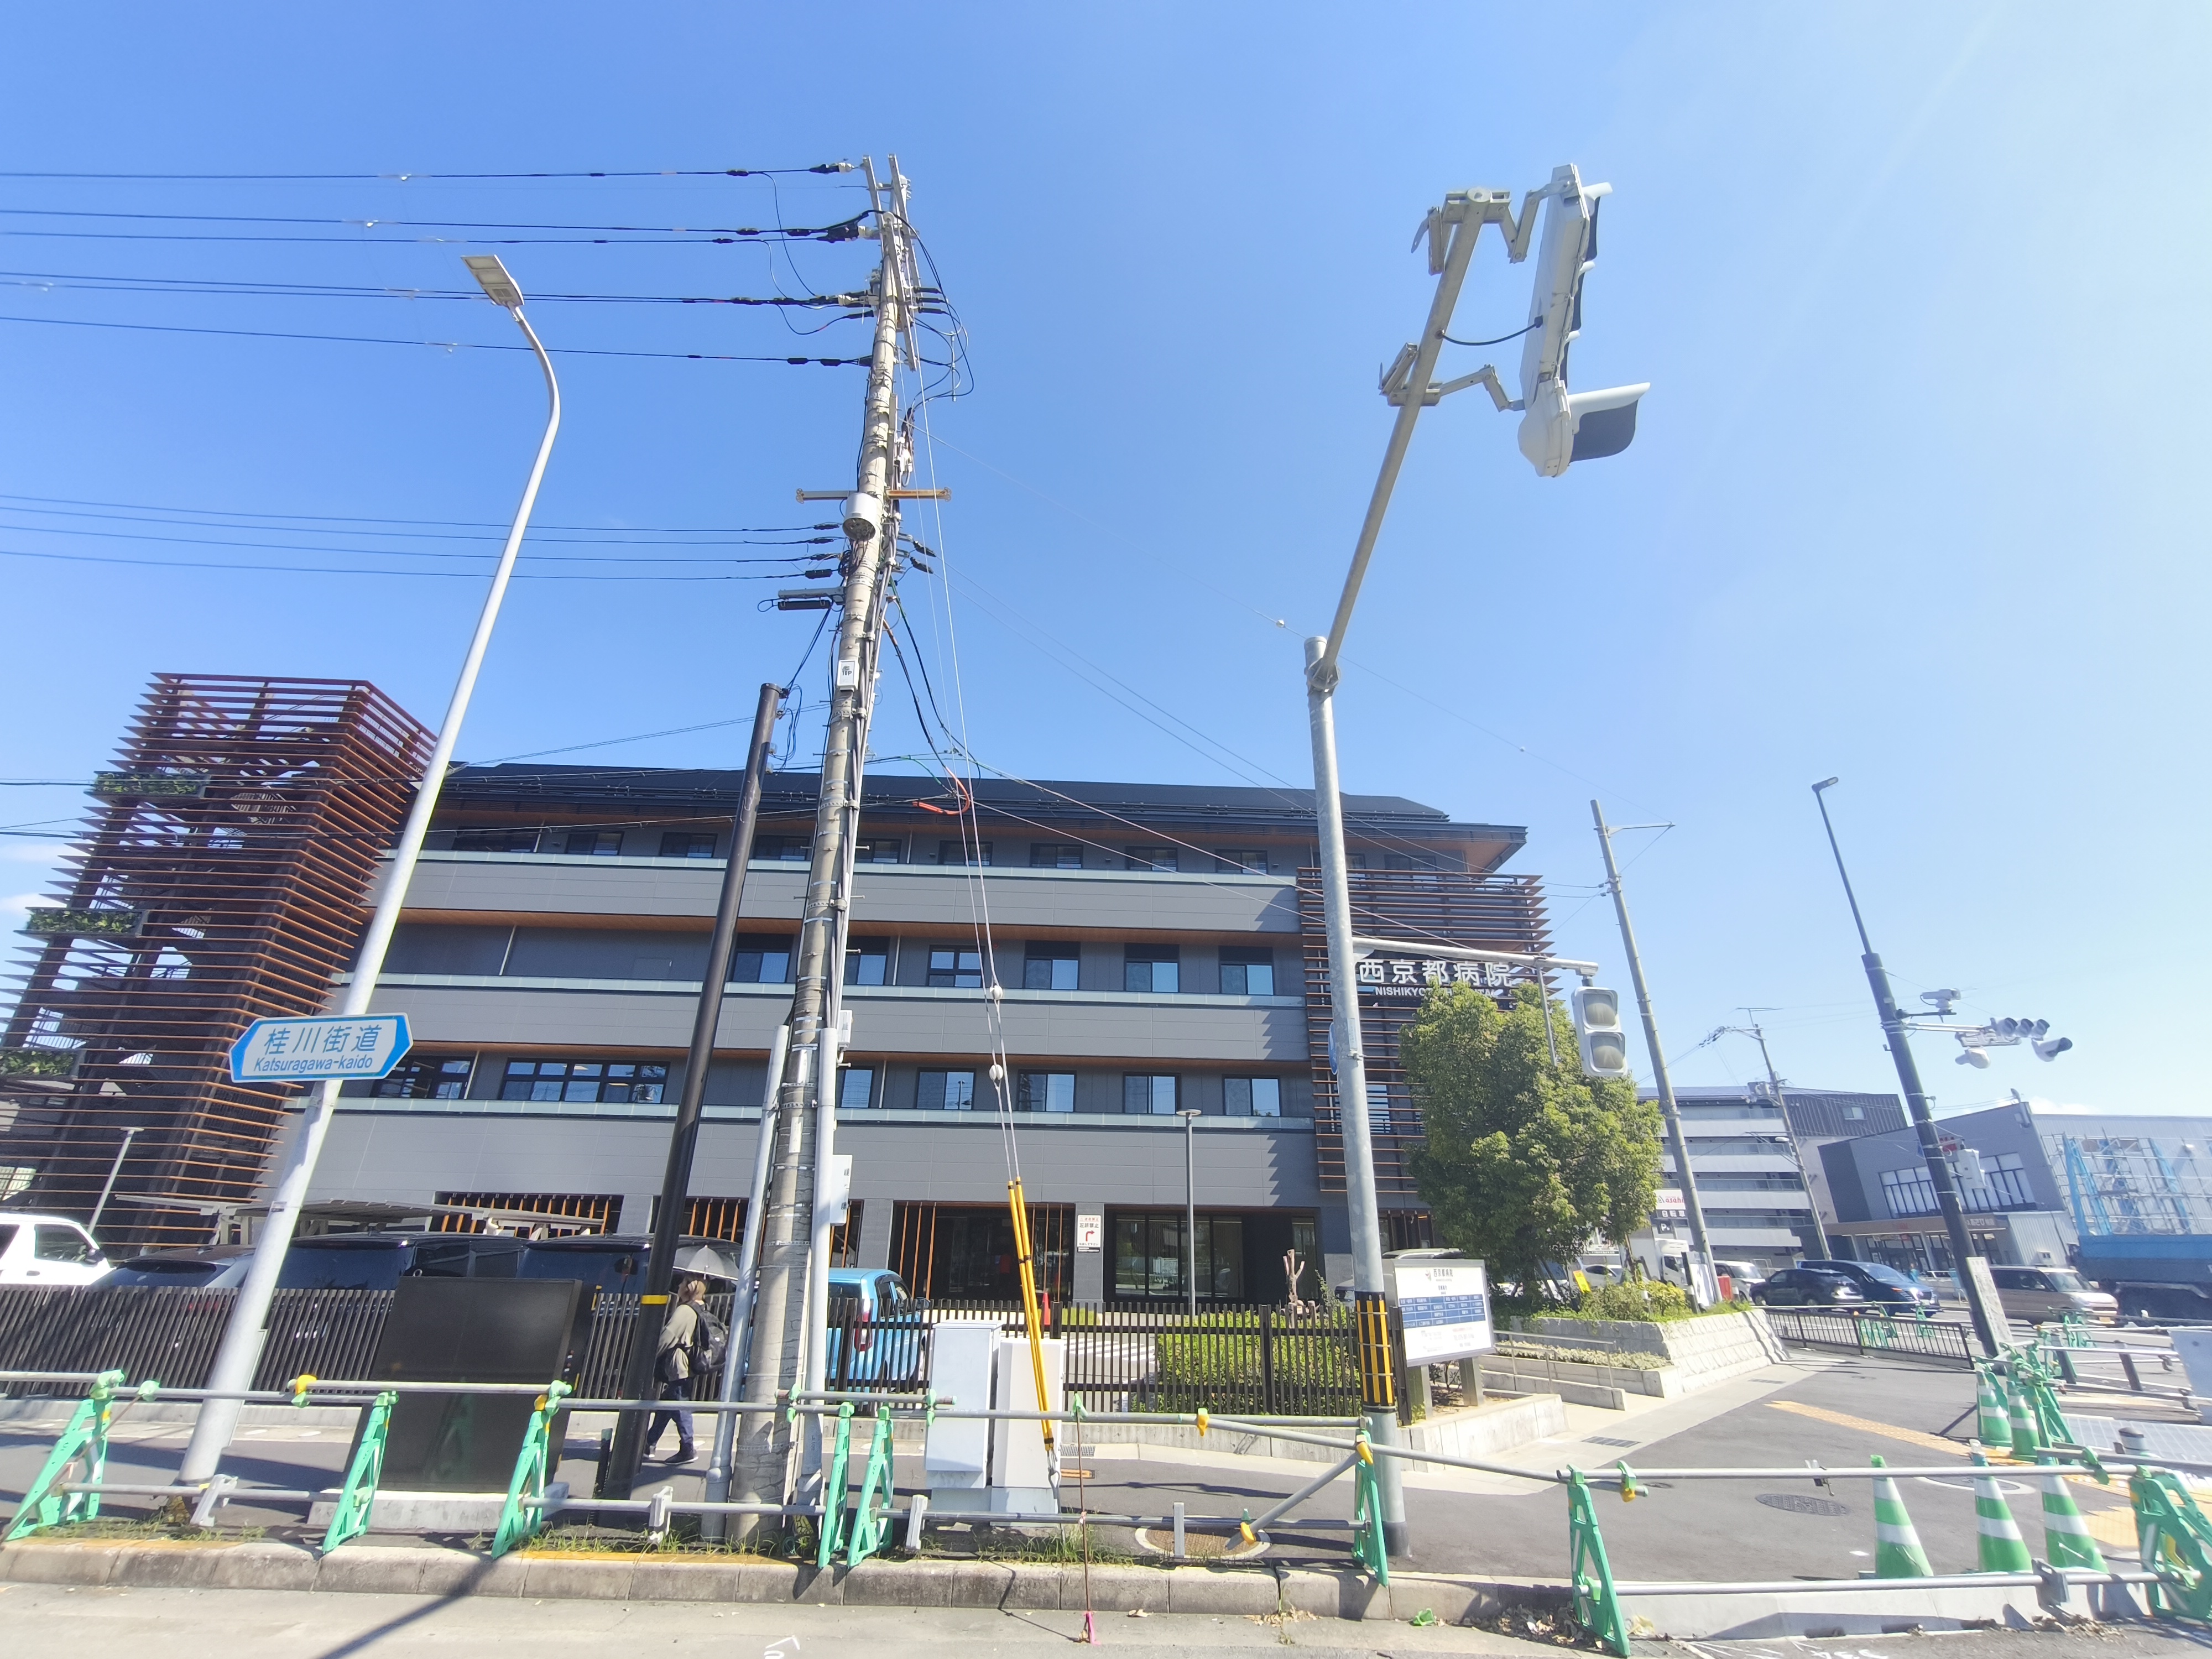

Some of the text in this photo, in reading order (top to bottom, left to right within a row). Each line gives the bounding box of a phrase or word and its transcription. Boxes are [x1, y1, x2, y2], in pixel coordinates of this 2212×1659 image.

[1359, 959, 1512, 987] 西京都病院
[264, 1024, 382, 1055] 桂川街道
[253, 1054, 373, 1073] Katsuragawa-kaido
